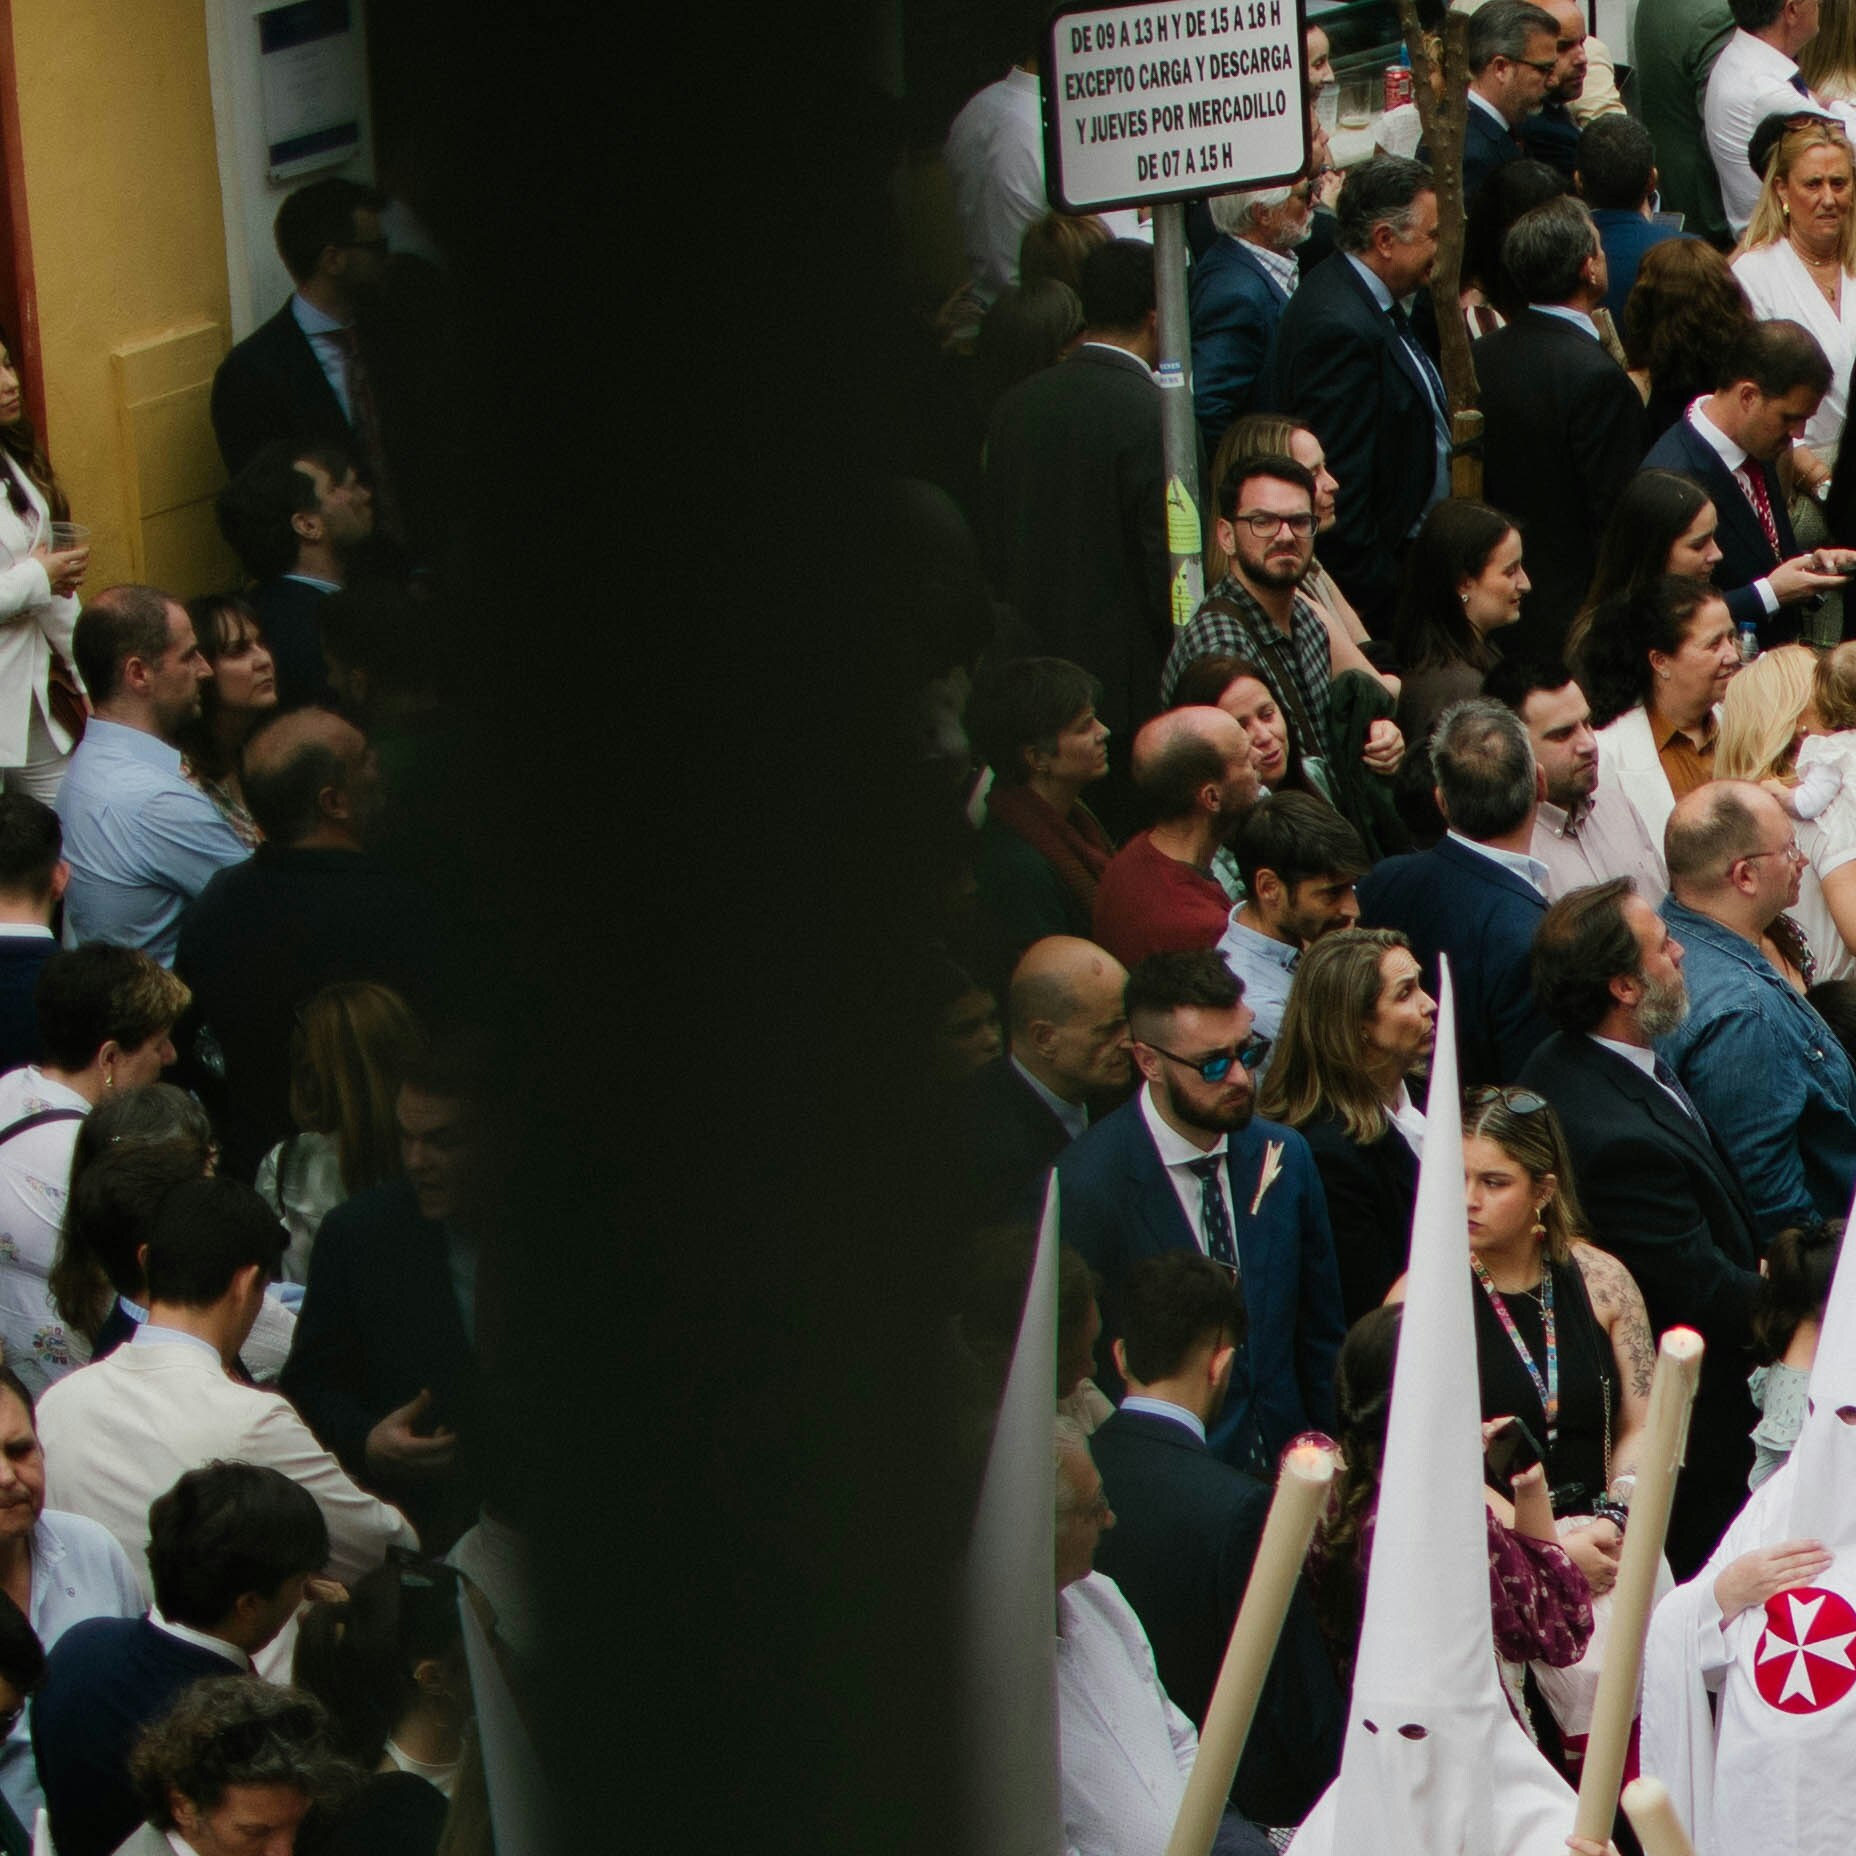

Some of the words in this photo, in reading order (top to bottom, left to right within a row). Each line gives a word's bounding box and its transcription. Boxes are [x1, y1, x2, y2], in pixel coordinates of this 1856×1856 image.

[1071, 25, 1092, 54] DE
[1096, 22, 1115, 50] 09
[1120, 20, 1131, 48] A
[1134, 17, 1152, 46] 13
[1157, 15, 1168, 42] H
[1171, 13, 1182, 40] Y
[1186, 10, 1206, 39] DE
[1211, 7, 1229, 35] 15
[1233, 5, 1244, 32] A
[1248, 2, 1266, 30] 18
[1270, 0, 1281, 27] H
[1065, 66, 1134, 101] EXCEPTO
[1139, 57, 1192, 90] CARGA
[1195, 55, 1206, 82] Y
[1210, 44, 1292, 81] DESCARGA
[1075, 118, 1087, 145] Y
[1090, 109, 1147, 144] JUEVES
[1152, 104, 1184, 134] POR
[1189, 89, 1286, 129] MERCADILLO
[1137, 154, 1158, 182] DE
[1162, 150, 1180, 177] 07
[1185, 148, 1196, 175] A
[1200, 145, 1218, 173] 15
[1222, 142, 1233, 169] H
